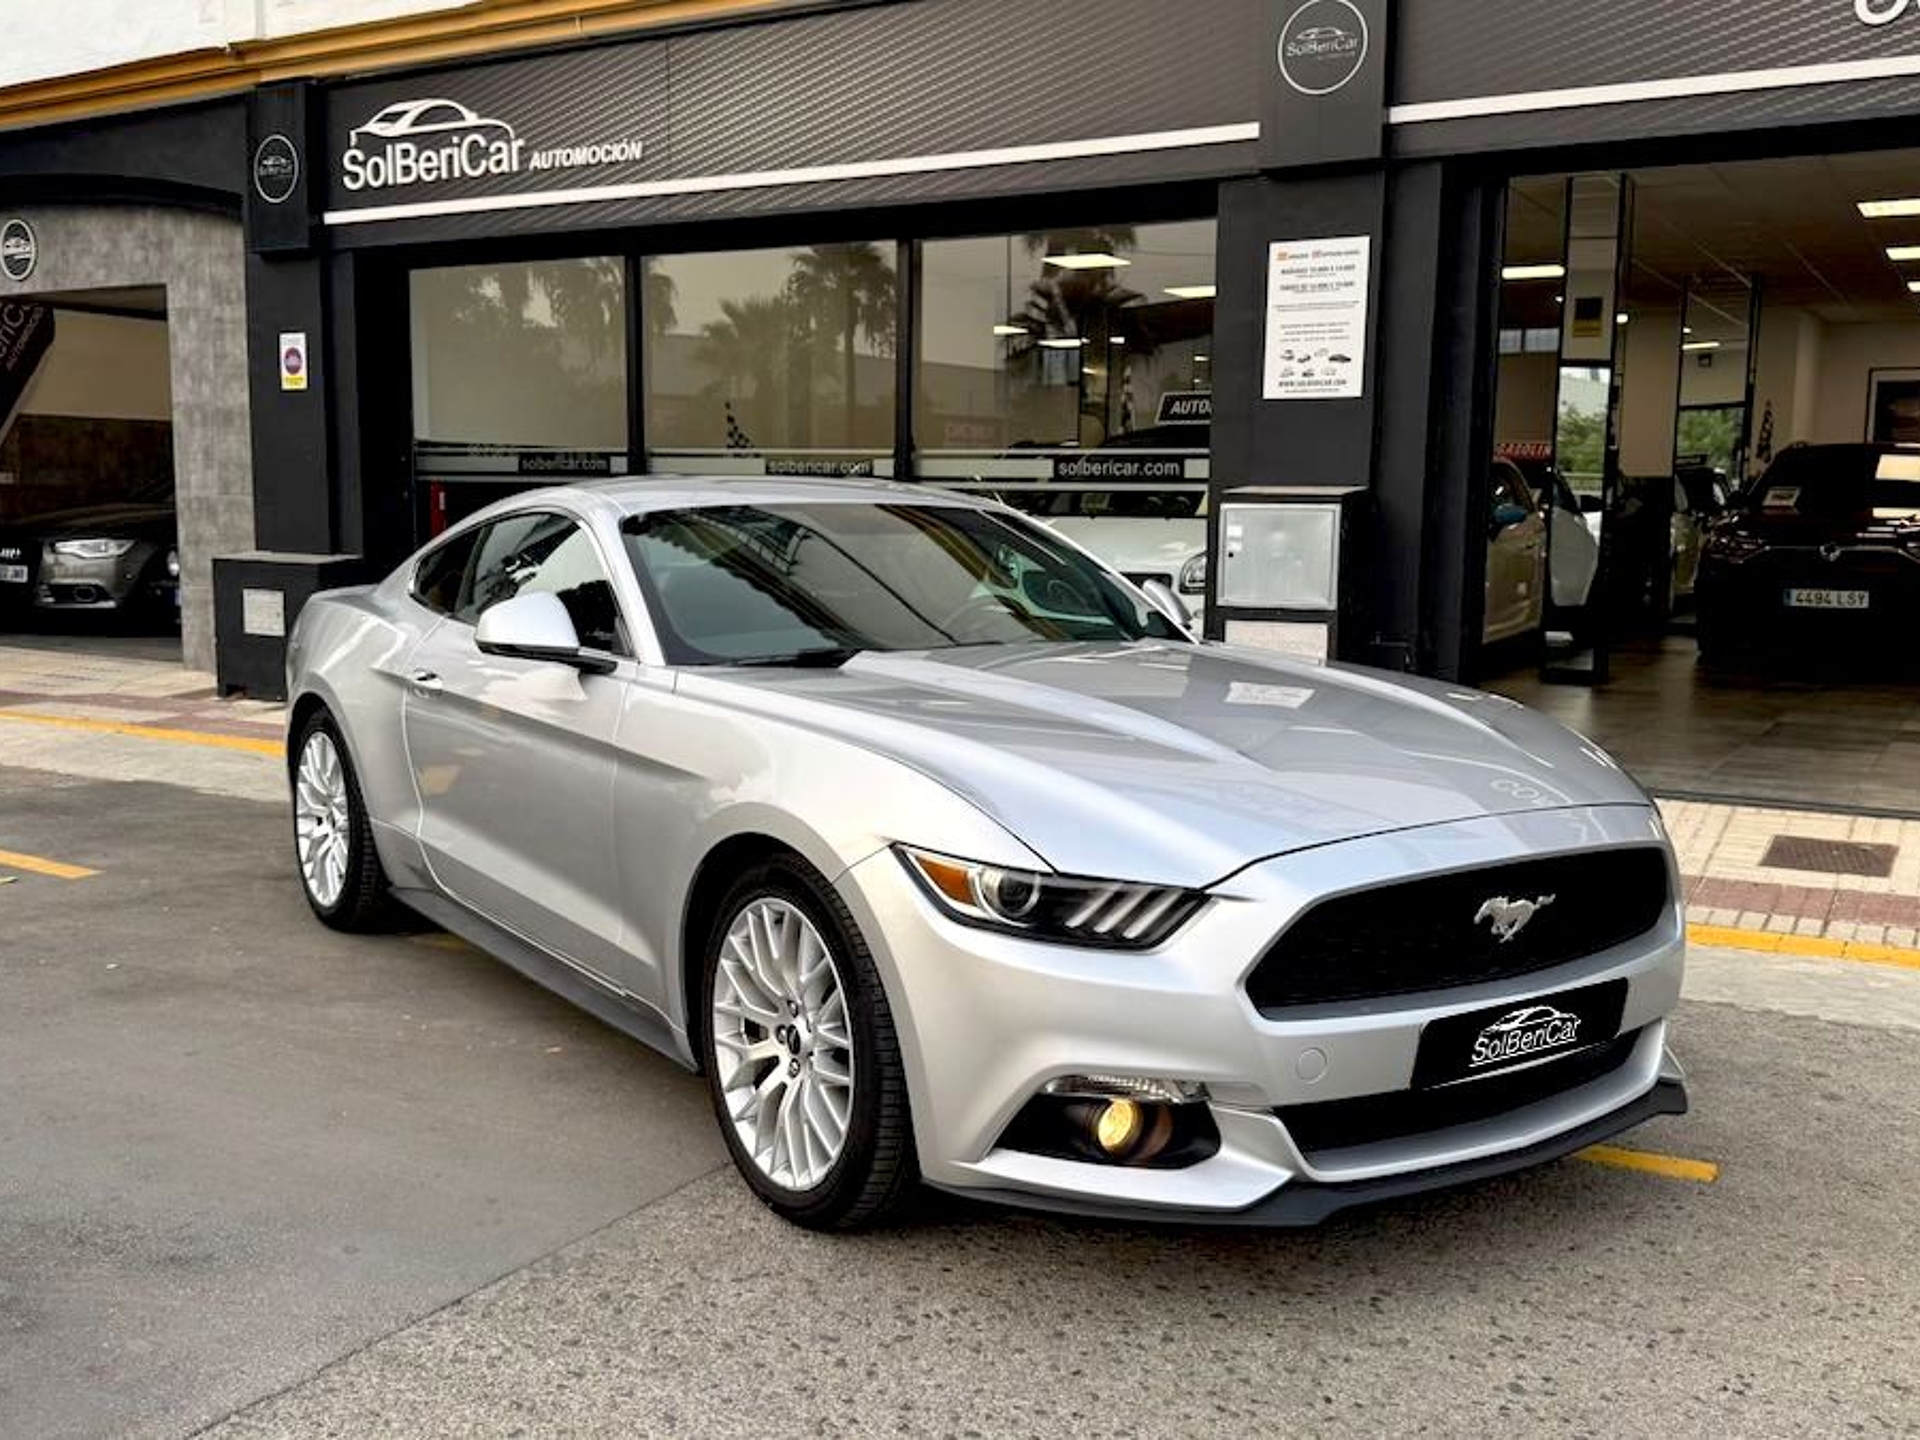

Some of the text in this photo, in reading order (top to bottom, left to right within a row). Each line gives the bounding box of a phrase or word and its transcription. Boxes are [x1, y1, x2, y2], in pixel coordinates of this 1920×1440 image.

[342, 134, 643, 190] SolBeriCar AUTOMOCIÓN
[1169, 400, 1211, 415] AUTO
[1058, 457, 1181, 476] solbericar.com
[1836, 592, 1866, 606] LSY
[1472, 1019, 1581, 1062] SolBeriCar
